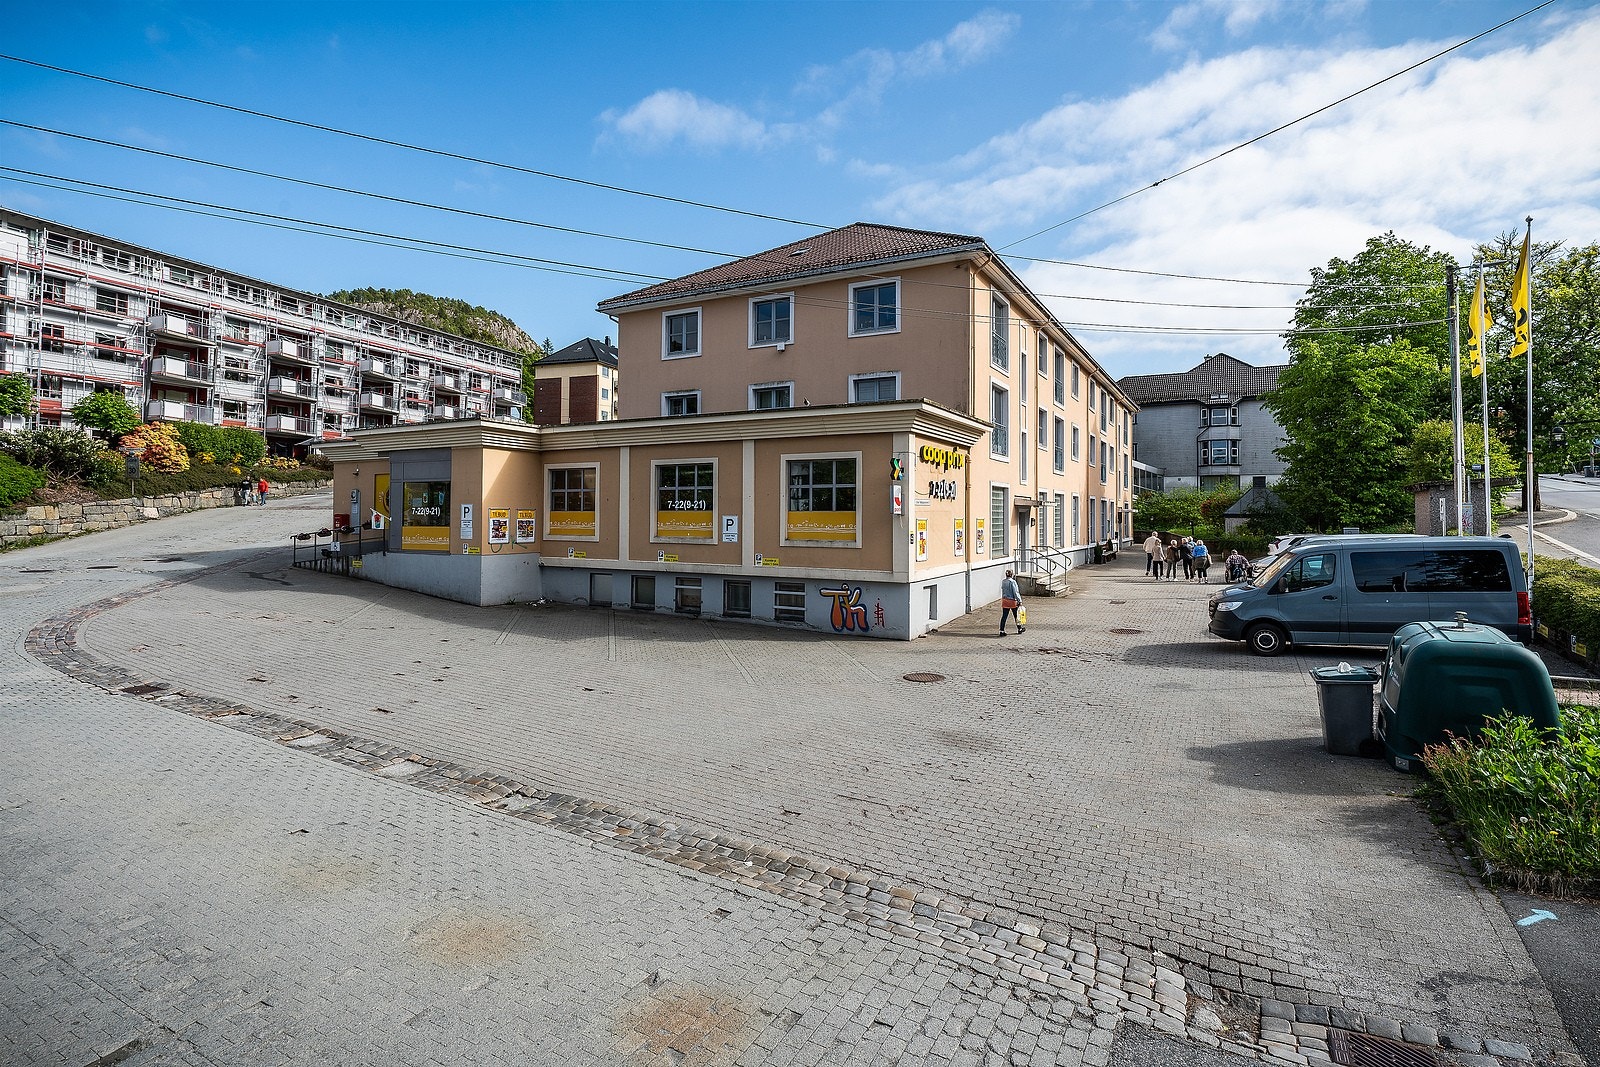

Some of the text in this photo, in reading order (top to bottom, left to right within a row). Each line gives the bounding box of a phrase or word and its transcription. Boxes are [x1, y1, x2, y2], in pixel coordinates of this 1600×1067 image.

[922, 445, 965, 469] coop prix
[411, 506, 441, 517] 7-22(9-21)
[667, 500, 707, 511] 7-22(9-21)
[463, 506, 470, 519] P
[726, 518, 734, 531] P
